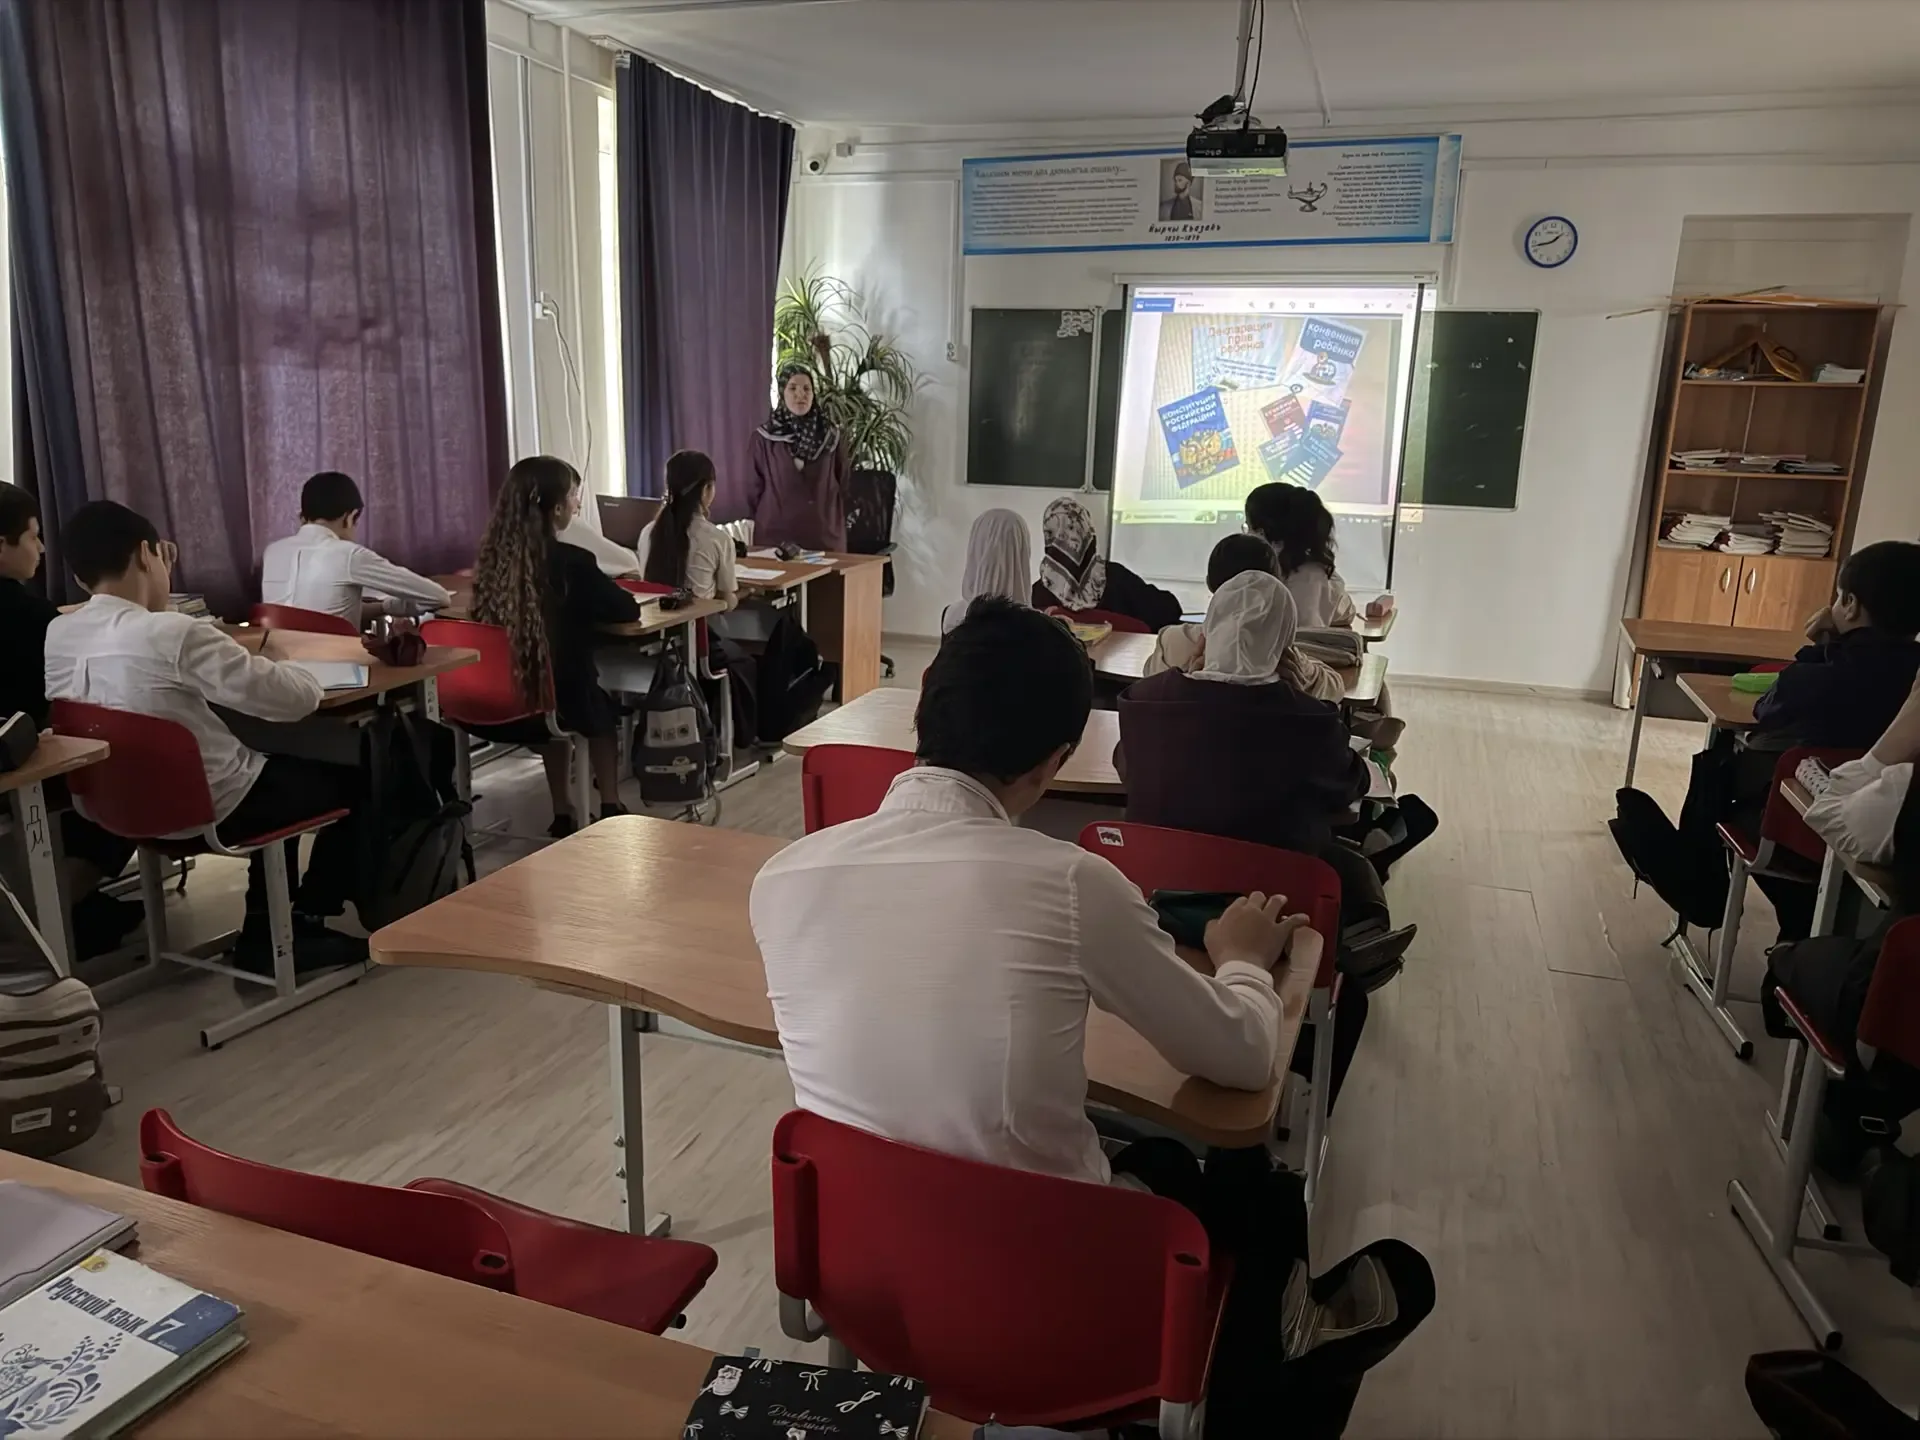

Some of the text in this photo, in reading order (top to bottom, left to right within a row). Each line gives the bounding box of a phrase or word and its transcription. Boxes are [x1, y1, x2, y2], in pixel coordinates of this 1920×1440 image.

[1162, 393, 1216, 420] КОНСТИТУЦИЯ
[1165, 401, 1217, 427] РОССИЙСКОЙ
[1171, 410, 1216, 432] ФЕДЕРАЦИИ
[44, 1276, 148, 1334] Русский язык
[147, 1318, 187, 1341] 7
